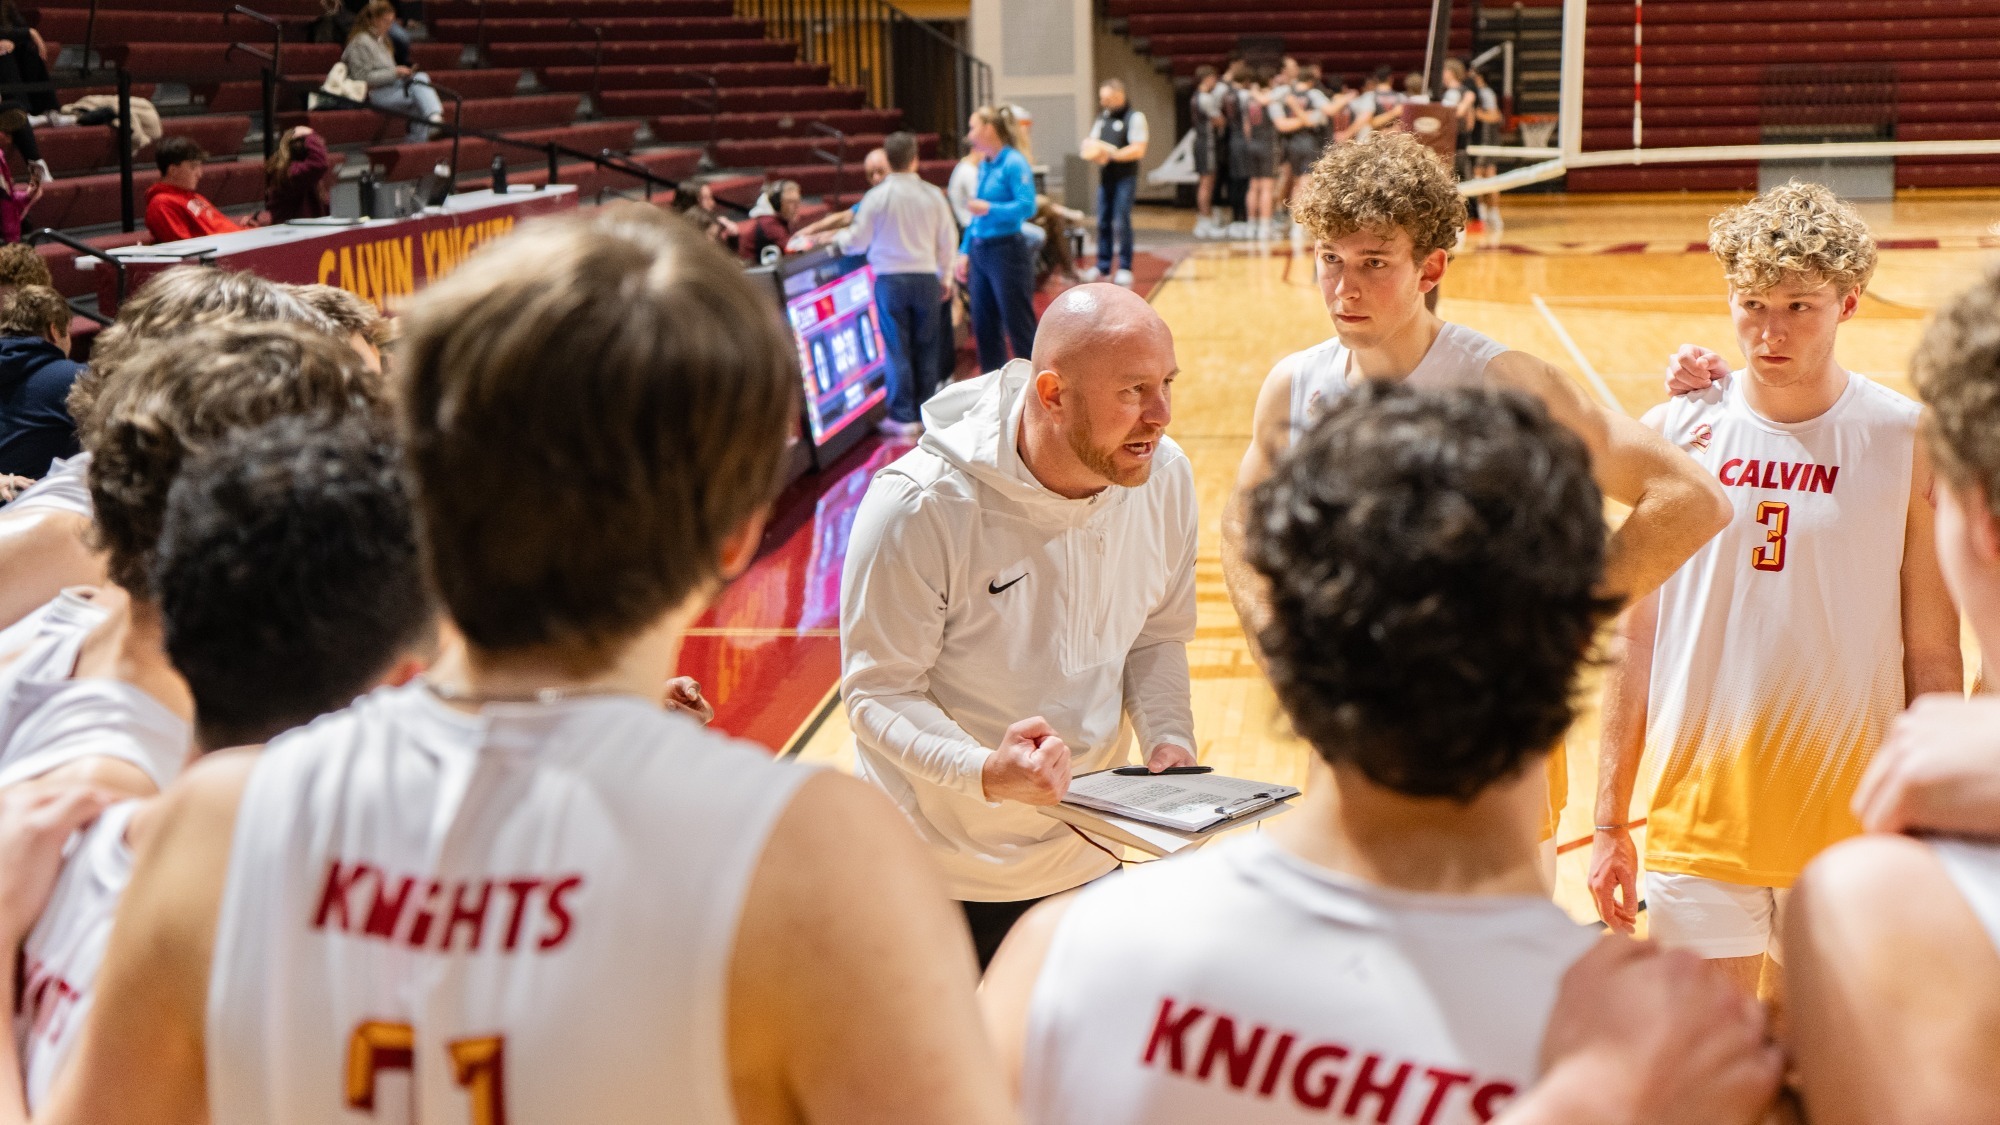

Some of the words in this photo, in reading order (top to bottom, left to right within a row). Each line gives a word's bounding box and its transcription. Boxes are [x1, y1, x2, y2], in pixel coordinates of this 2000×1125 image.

[1719, 457, 1840, 495] CALVIN
[1751, 500, 1790, 572] 3
[312, 859, 583, 952] KNHTS
